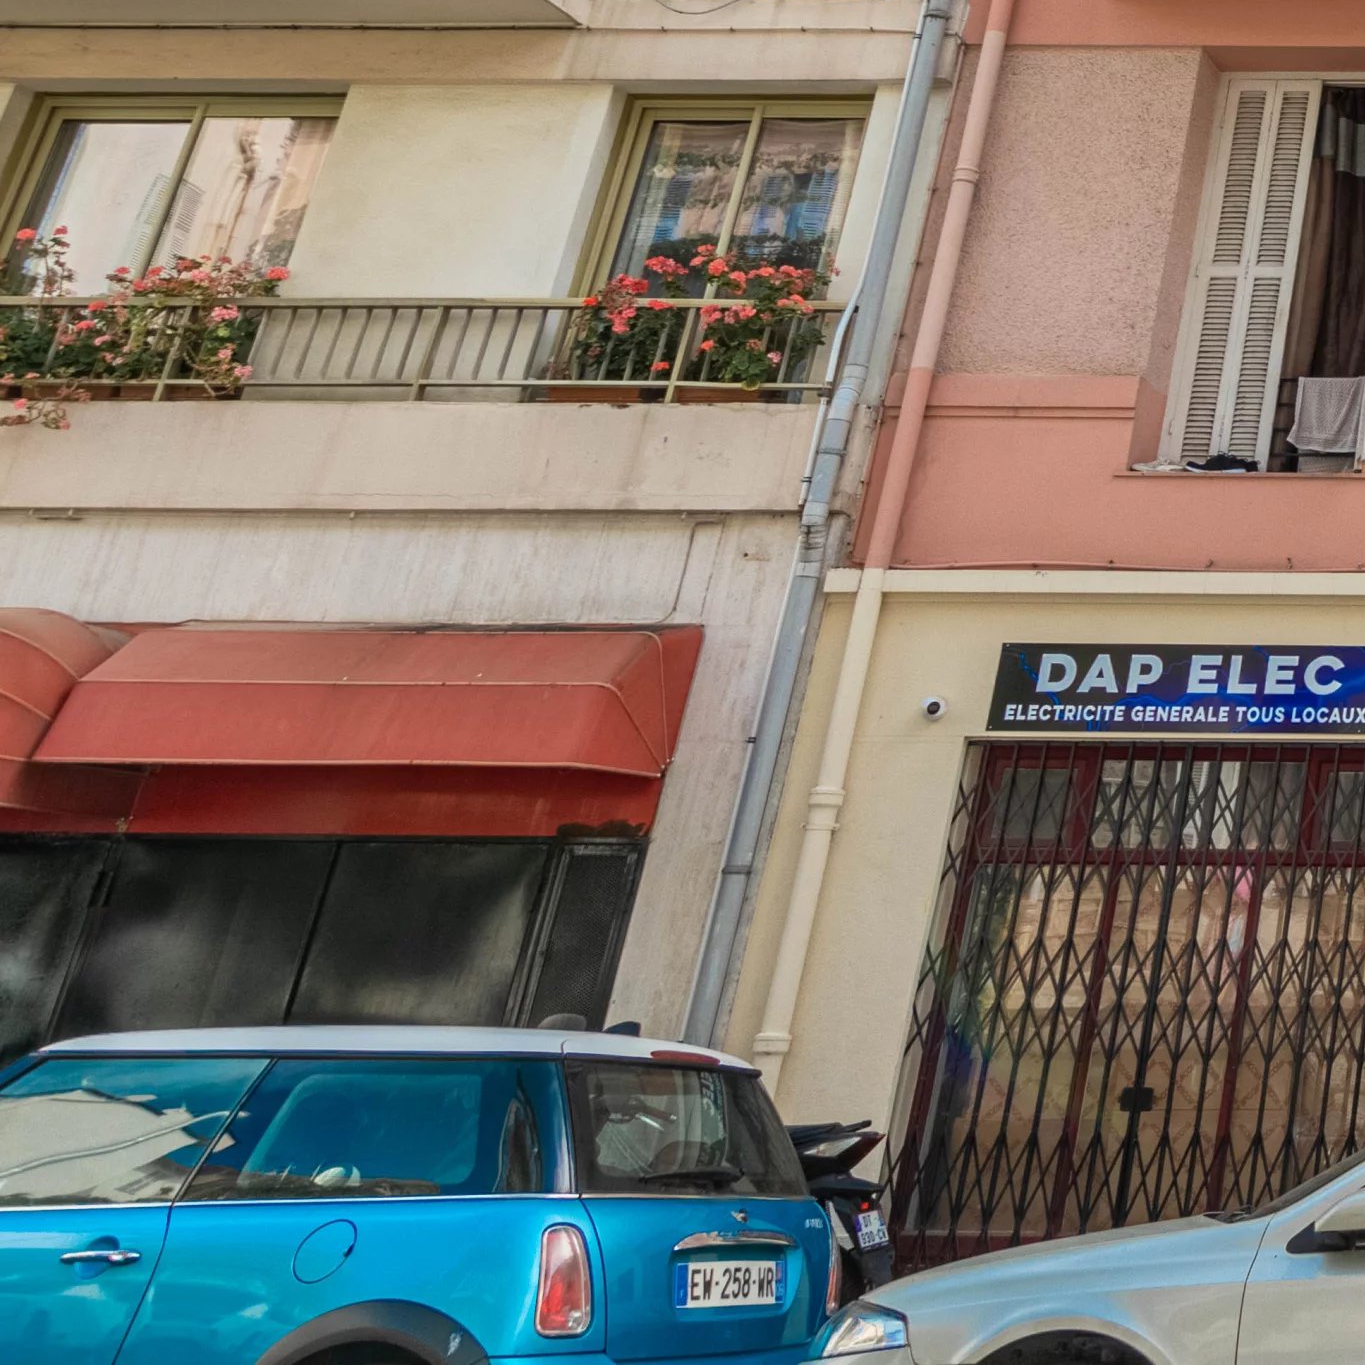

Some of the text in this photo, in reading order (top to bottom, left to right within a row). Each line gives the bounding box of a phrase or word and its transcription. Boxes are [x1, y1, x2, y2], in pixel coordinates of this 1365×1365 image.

[1035, 653, 1346, 696] DAP ELEC
[1003, 704, 1127, 722] ELECTRICITE
[1131, 705, 1230, 723] GENERALE
[1235, 706, 1285, 724] TOUS
[690, 1266, 774, 1301] EW-258-WR
